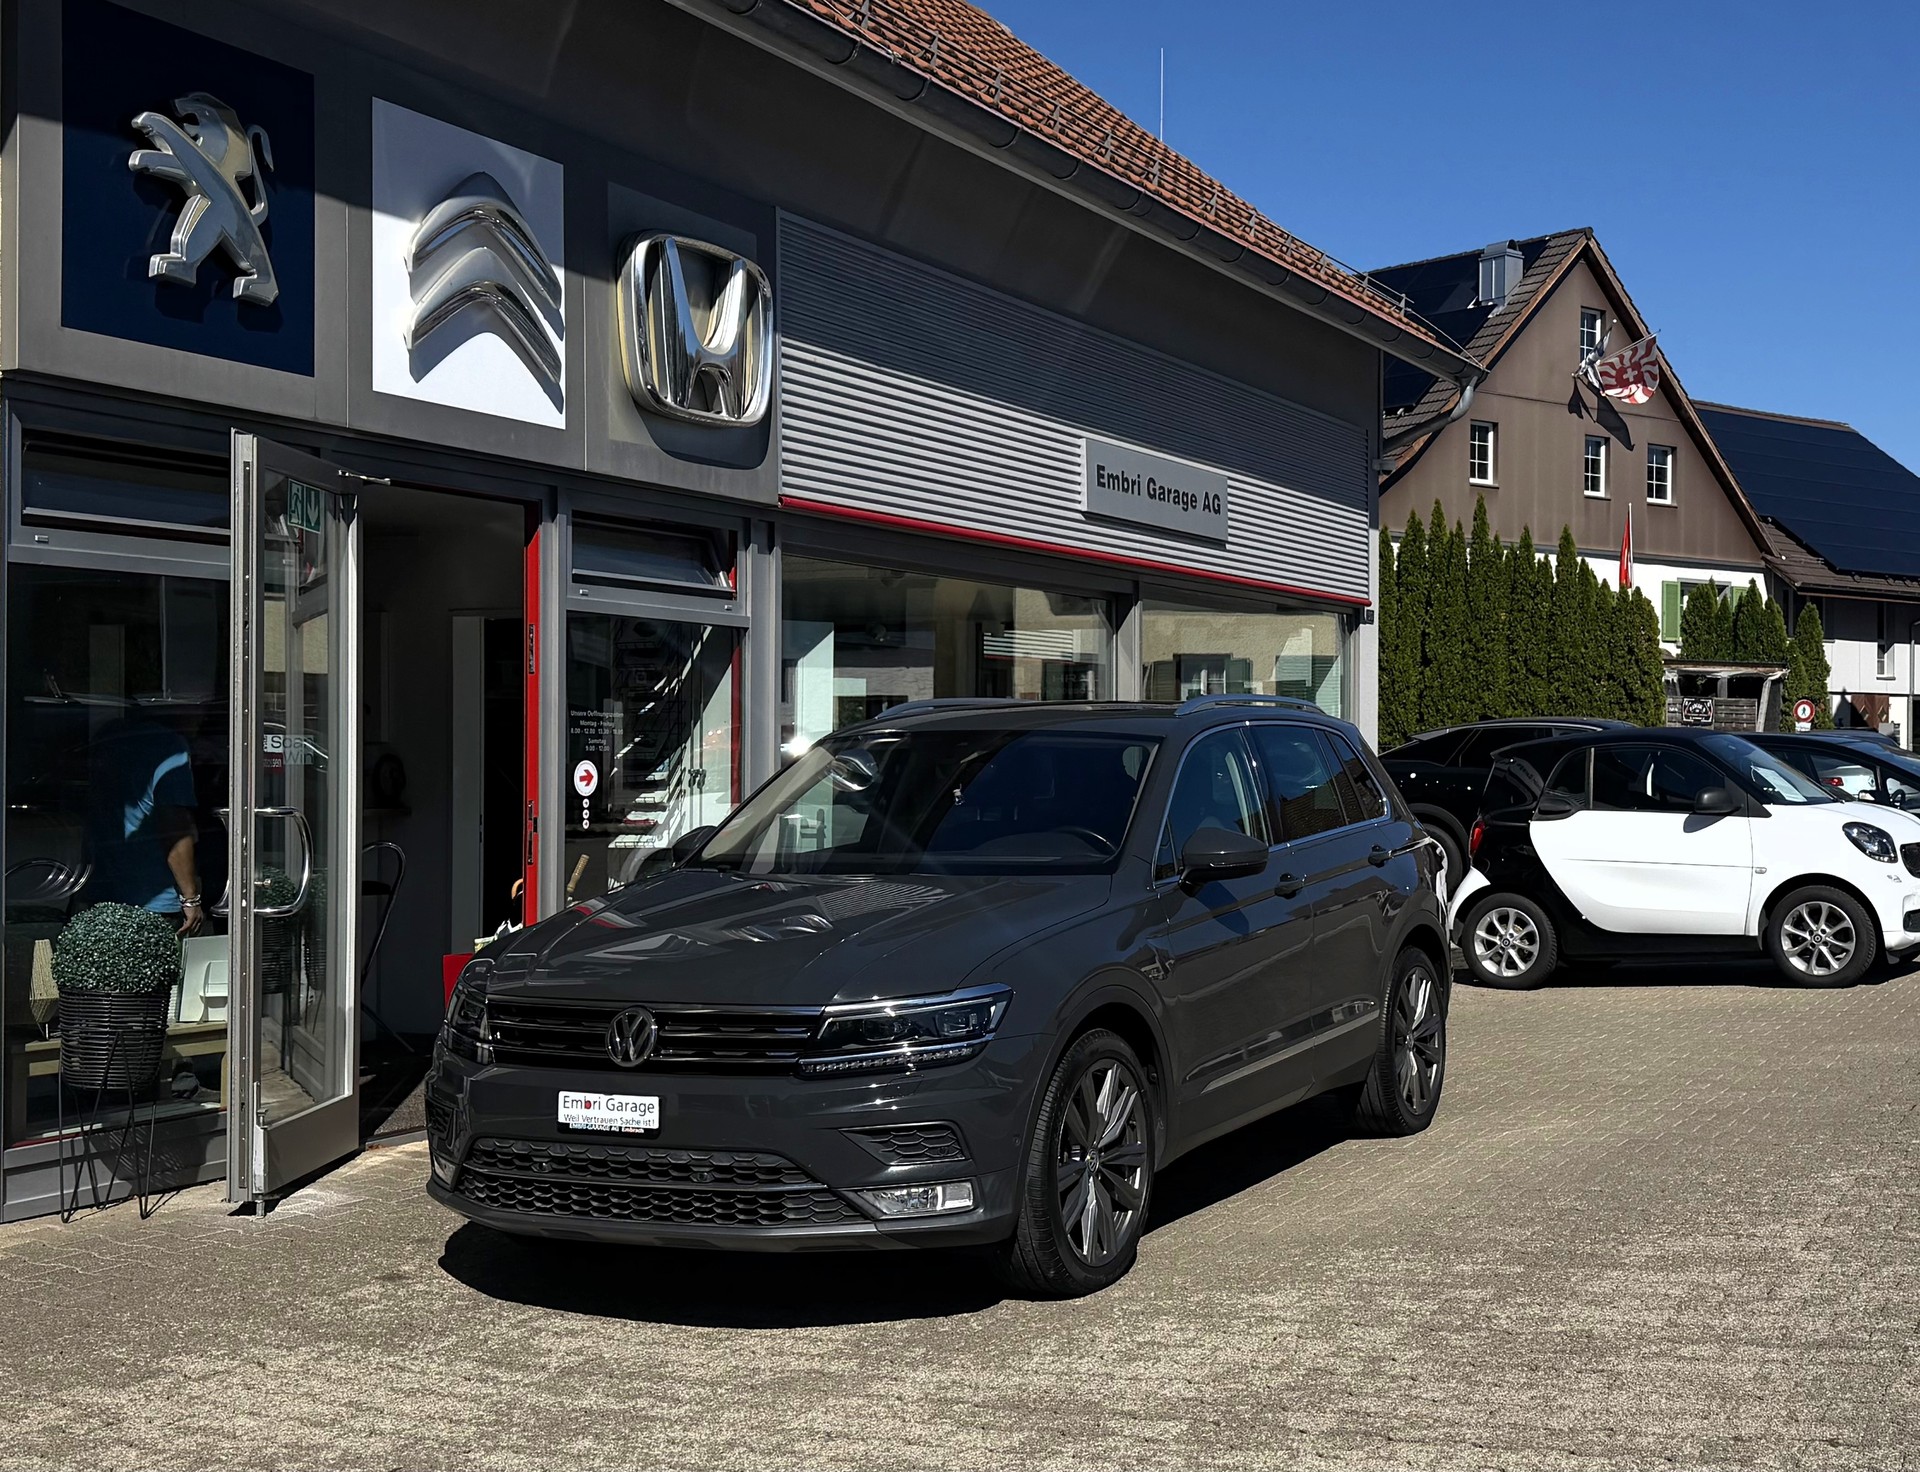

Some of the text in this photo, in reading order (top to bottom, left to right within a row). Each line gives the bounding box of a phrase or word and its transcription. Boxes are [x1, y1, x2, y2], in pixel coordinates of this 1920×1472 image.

[1096, 463, 1221, 516] Embri Garage AG
[563, 1095, 655, 1117] Embri Garage
[563, 1113, 580, 1122] Weil
[581, 1114, 619, 1125] Vertrauen
[620, 1116, 641, 1126] Sache
